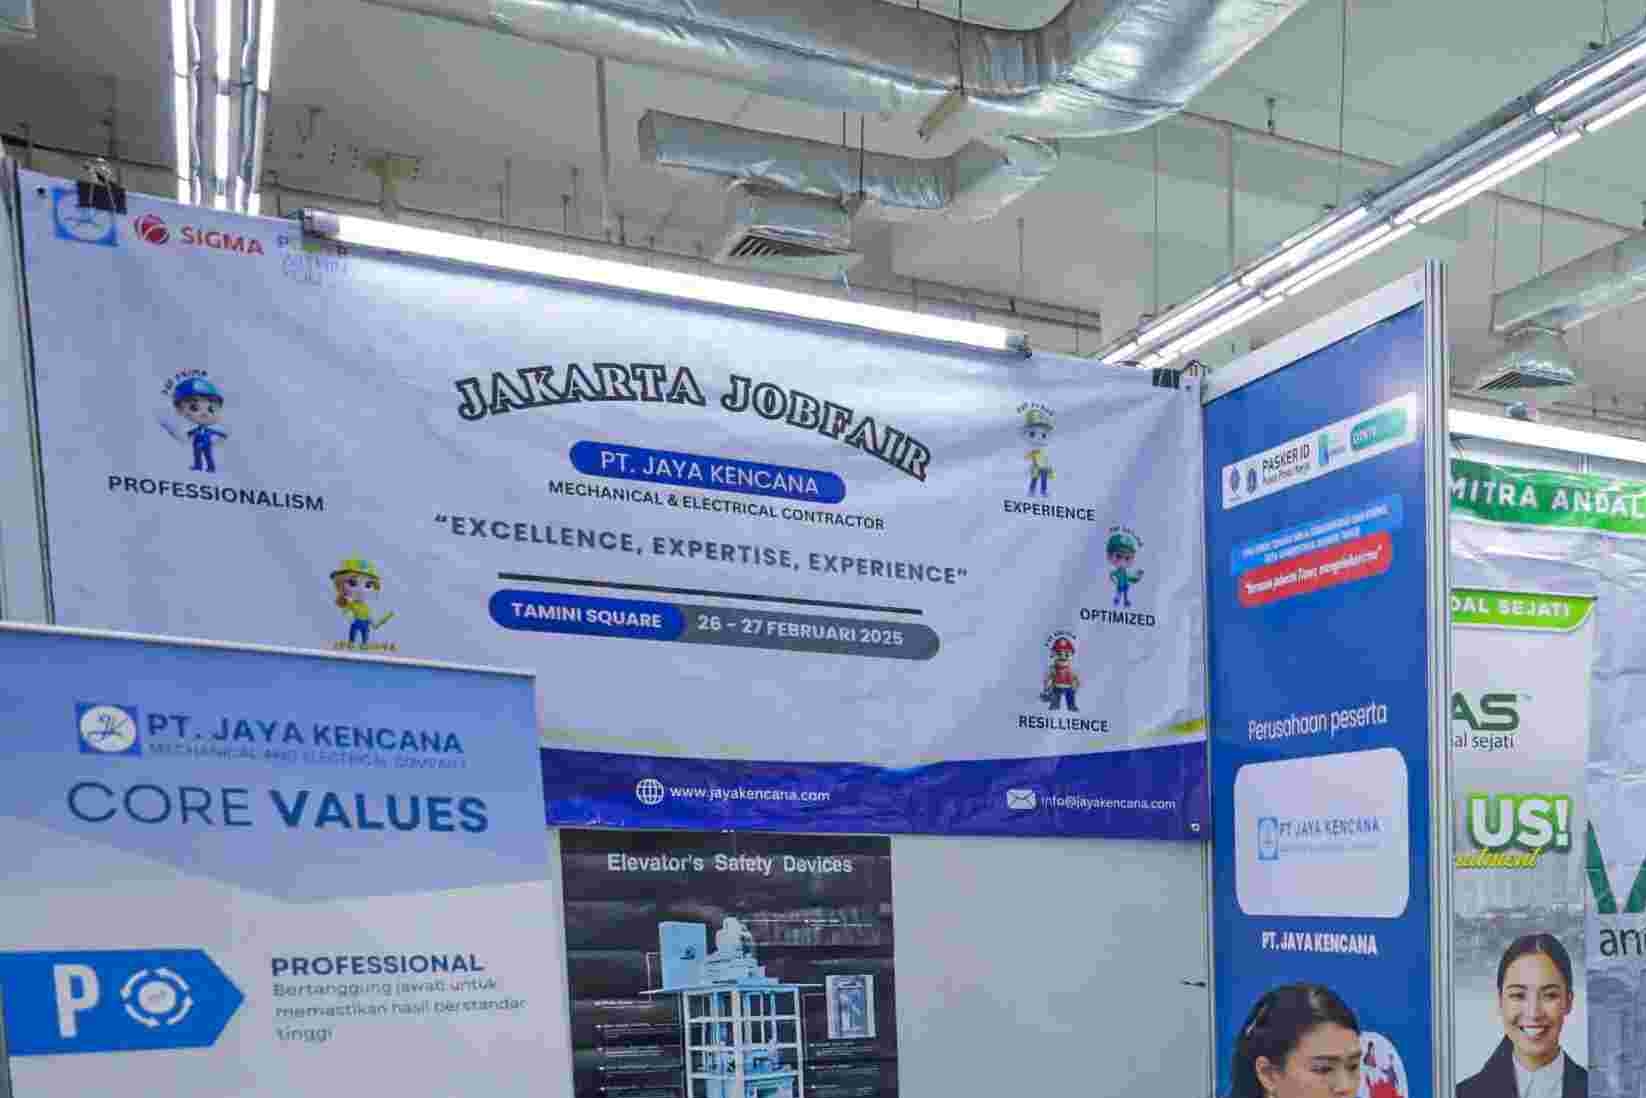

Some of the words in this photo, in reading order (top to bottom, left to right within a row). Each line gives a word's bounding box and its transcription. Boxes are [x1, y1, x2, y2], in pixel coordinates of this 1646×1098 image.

[181, 226, 265, 257] SIGMA
[455, 363, 706, 421] JAKARTA
[721, 375, 932, 483] JOBFAIR
[600, 450, 637, 475] PT.
[643, 456, 704, 482] JAYA
[710, 464, 819, 495] KENCANA
[1261, 447, 1299, 474] PASKER
[107, 475, 325, 512] PROFESSIONALISM
[548, 480, 662, 506] MECHANICAL
[667, 494, 680, 508] &
[682, 495, 778, 519] ELECTRICAL
[781, 506, 885, 531] CONTRACTOR
[1450, 475, 1540, 511] MITRA
[1551, 488, 1646, 519] ANDAL
[1003, 499, 1095, 522] EXPERIENCE
[652, 537, 800, 571] EXPERTISE,
[511, 602, 583, 624] TAMINI
[585, 606, 663, 630] SQUARE
[1079, 607, 1156, 628] OPTIMIZED
[1451, 597, 1489, 614] DAL
[1497, 600, 1571, 618] SEJATI
[697, 614, 722, 632] 26
[741, 616, 765, 634] 27
[766, 619, 858, 645] FEBRUARI
[859, 627, 904, 647] 2025
[1248, 710, 1329, 742] Perusahaan
[1330, 702, 1388, 737] peserta
[1451, 691, 1521, 732] AS
[147, 713, 201, 739] PT.
[212, 718, 304, 744] JAYA
[312, 723, 464, 754] KENCANA
[1471, 733, 1515, 751] sejati
[66, 781, 253, 827] CORE
[268, 788, 489, 834] VALUES
[670, 785, 831, 802] www.jayakencana.com
[1467, 797, 1570, 853] US!
[608, 853, 704, 874] Elevator's
[714, 854, 773, 877] Safety
[783, 856, 853, 874] Devices
[271, 953, 486, 977] PROFESSIONAL
[52, 963, 99, 1039] P
[276, 1024, 334, 1045] tinggi
